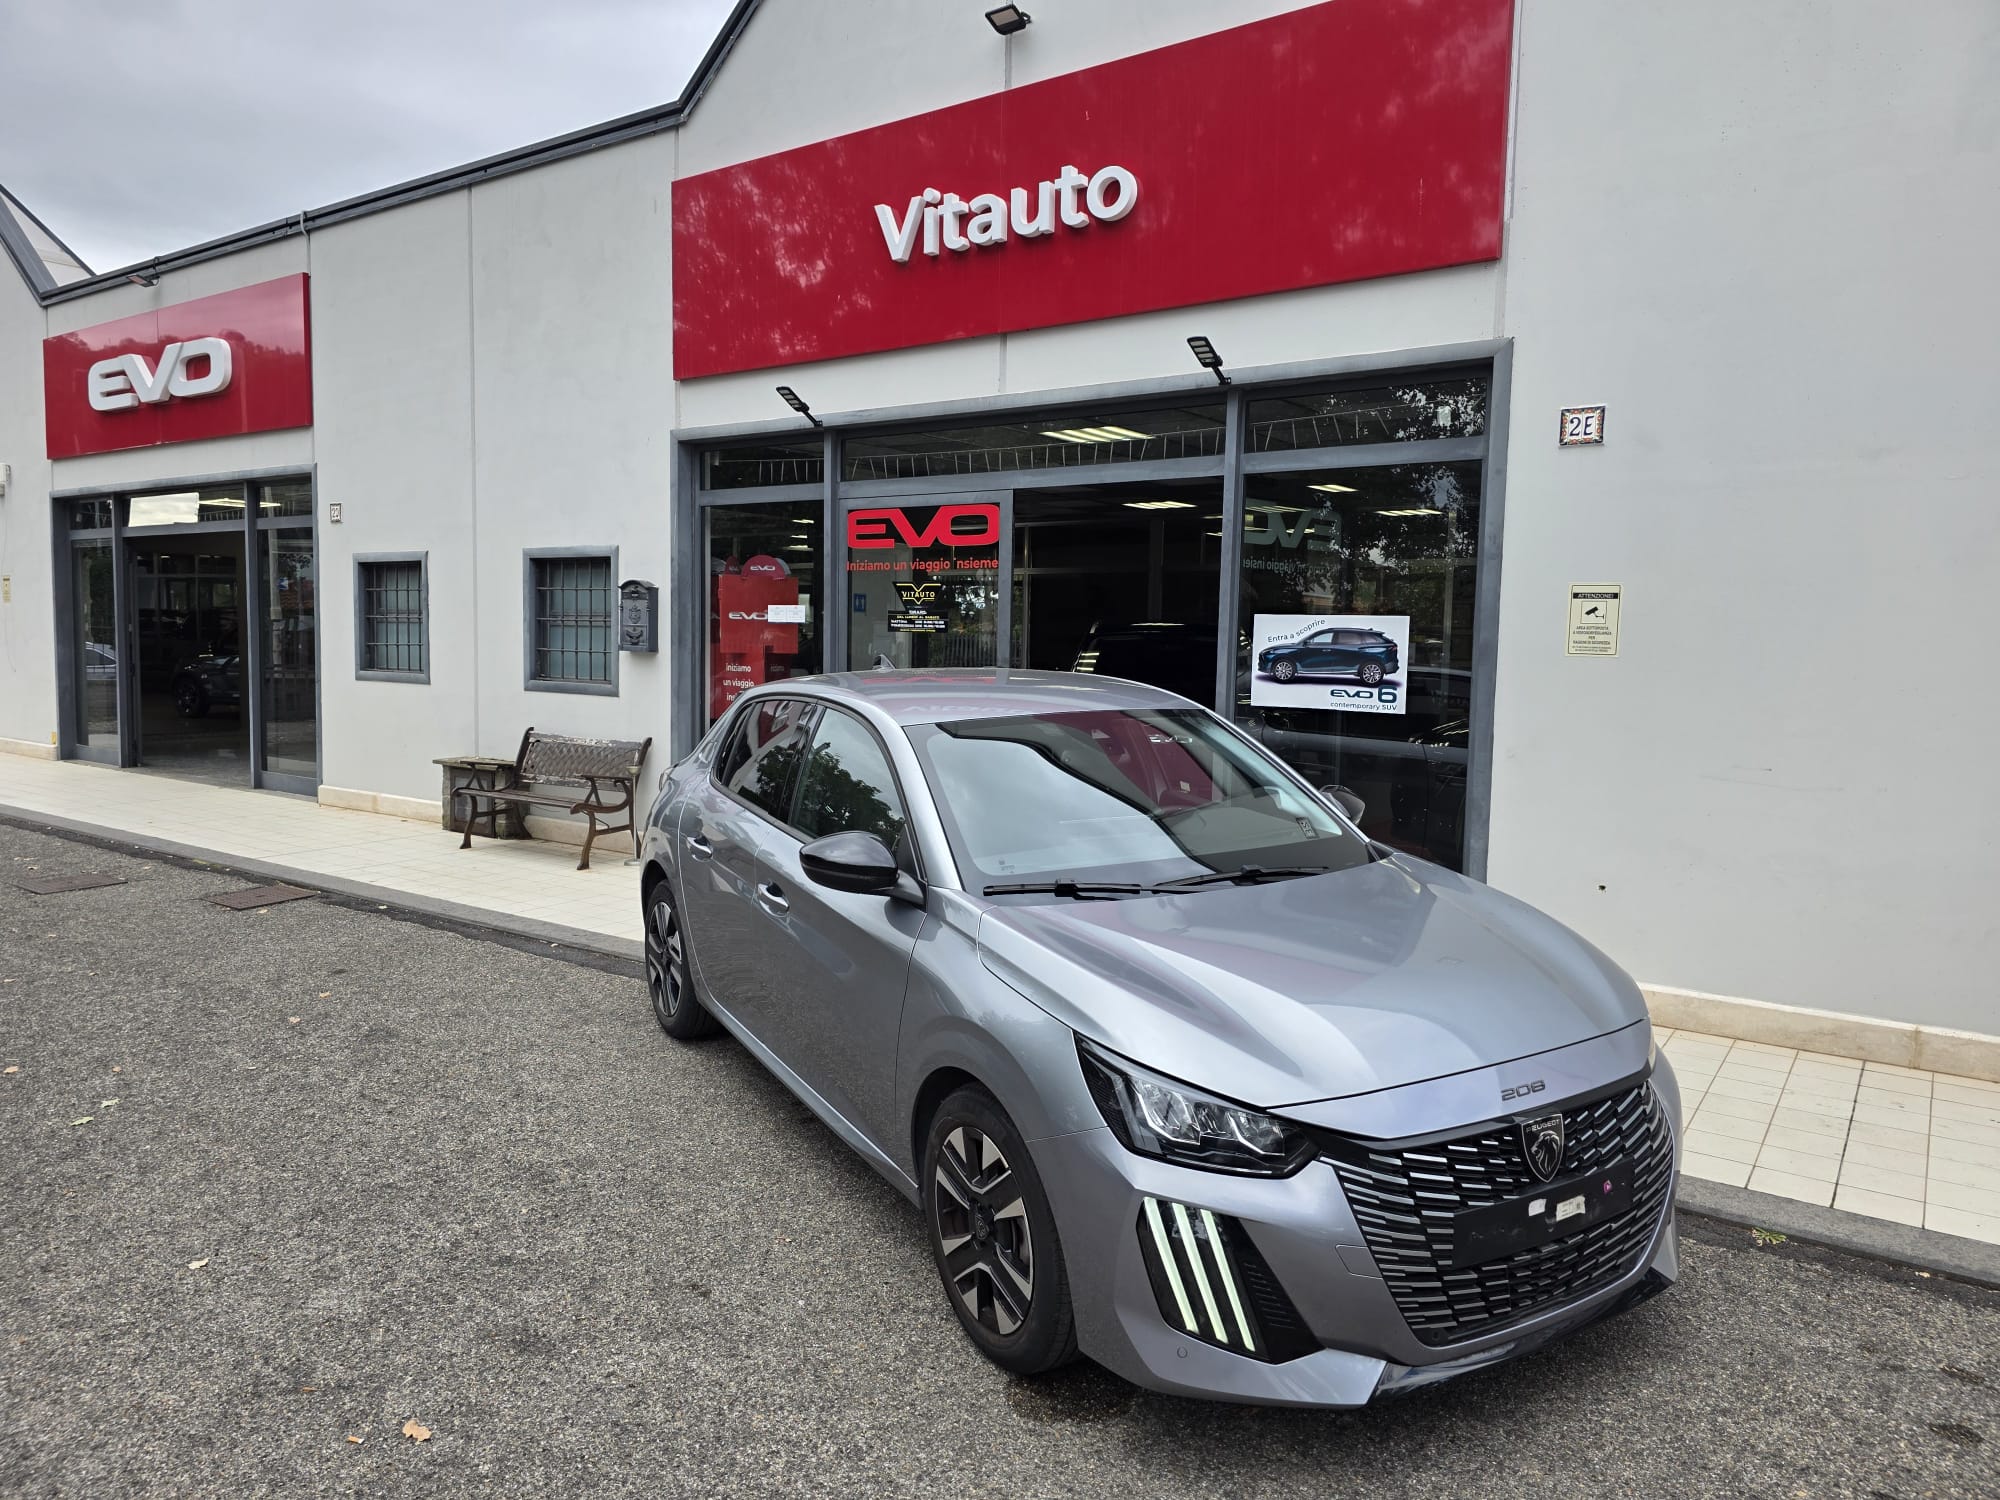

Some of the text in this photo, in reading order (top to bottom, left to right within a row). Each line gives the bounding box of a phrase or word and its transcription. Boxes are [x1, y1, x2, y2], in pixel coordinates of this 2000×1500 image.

[874, 165, 1138, 262] Vitauto
[88, 337, 232, 411] EVO
[1569, 415, 1595, 437] 2E
[847, 503, 1000, 549] EVO
[846, 556, 998, 573] Iniziamo un viaggio nsieme
[728, 611, 768, 620] EVO
[1268, 633, 1288, 643] Entra
[1295, 619, 1326, 637] scoprire
[1330, 685, 1398, 704] EVO 6
[1330, 701, 1381, 711] contemporary
[1501, 1079, 1546, 1101] 208
[1526, 1119, 1560, 1132] PEUGEOT
